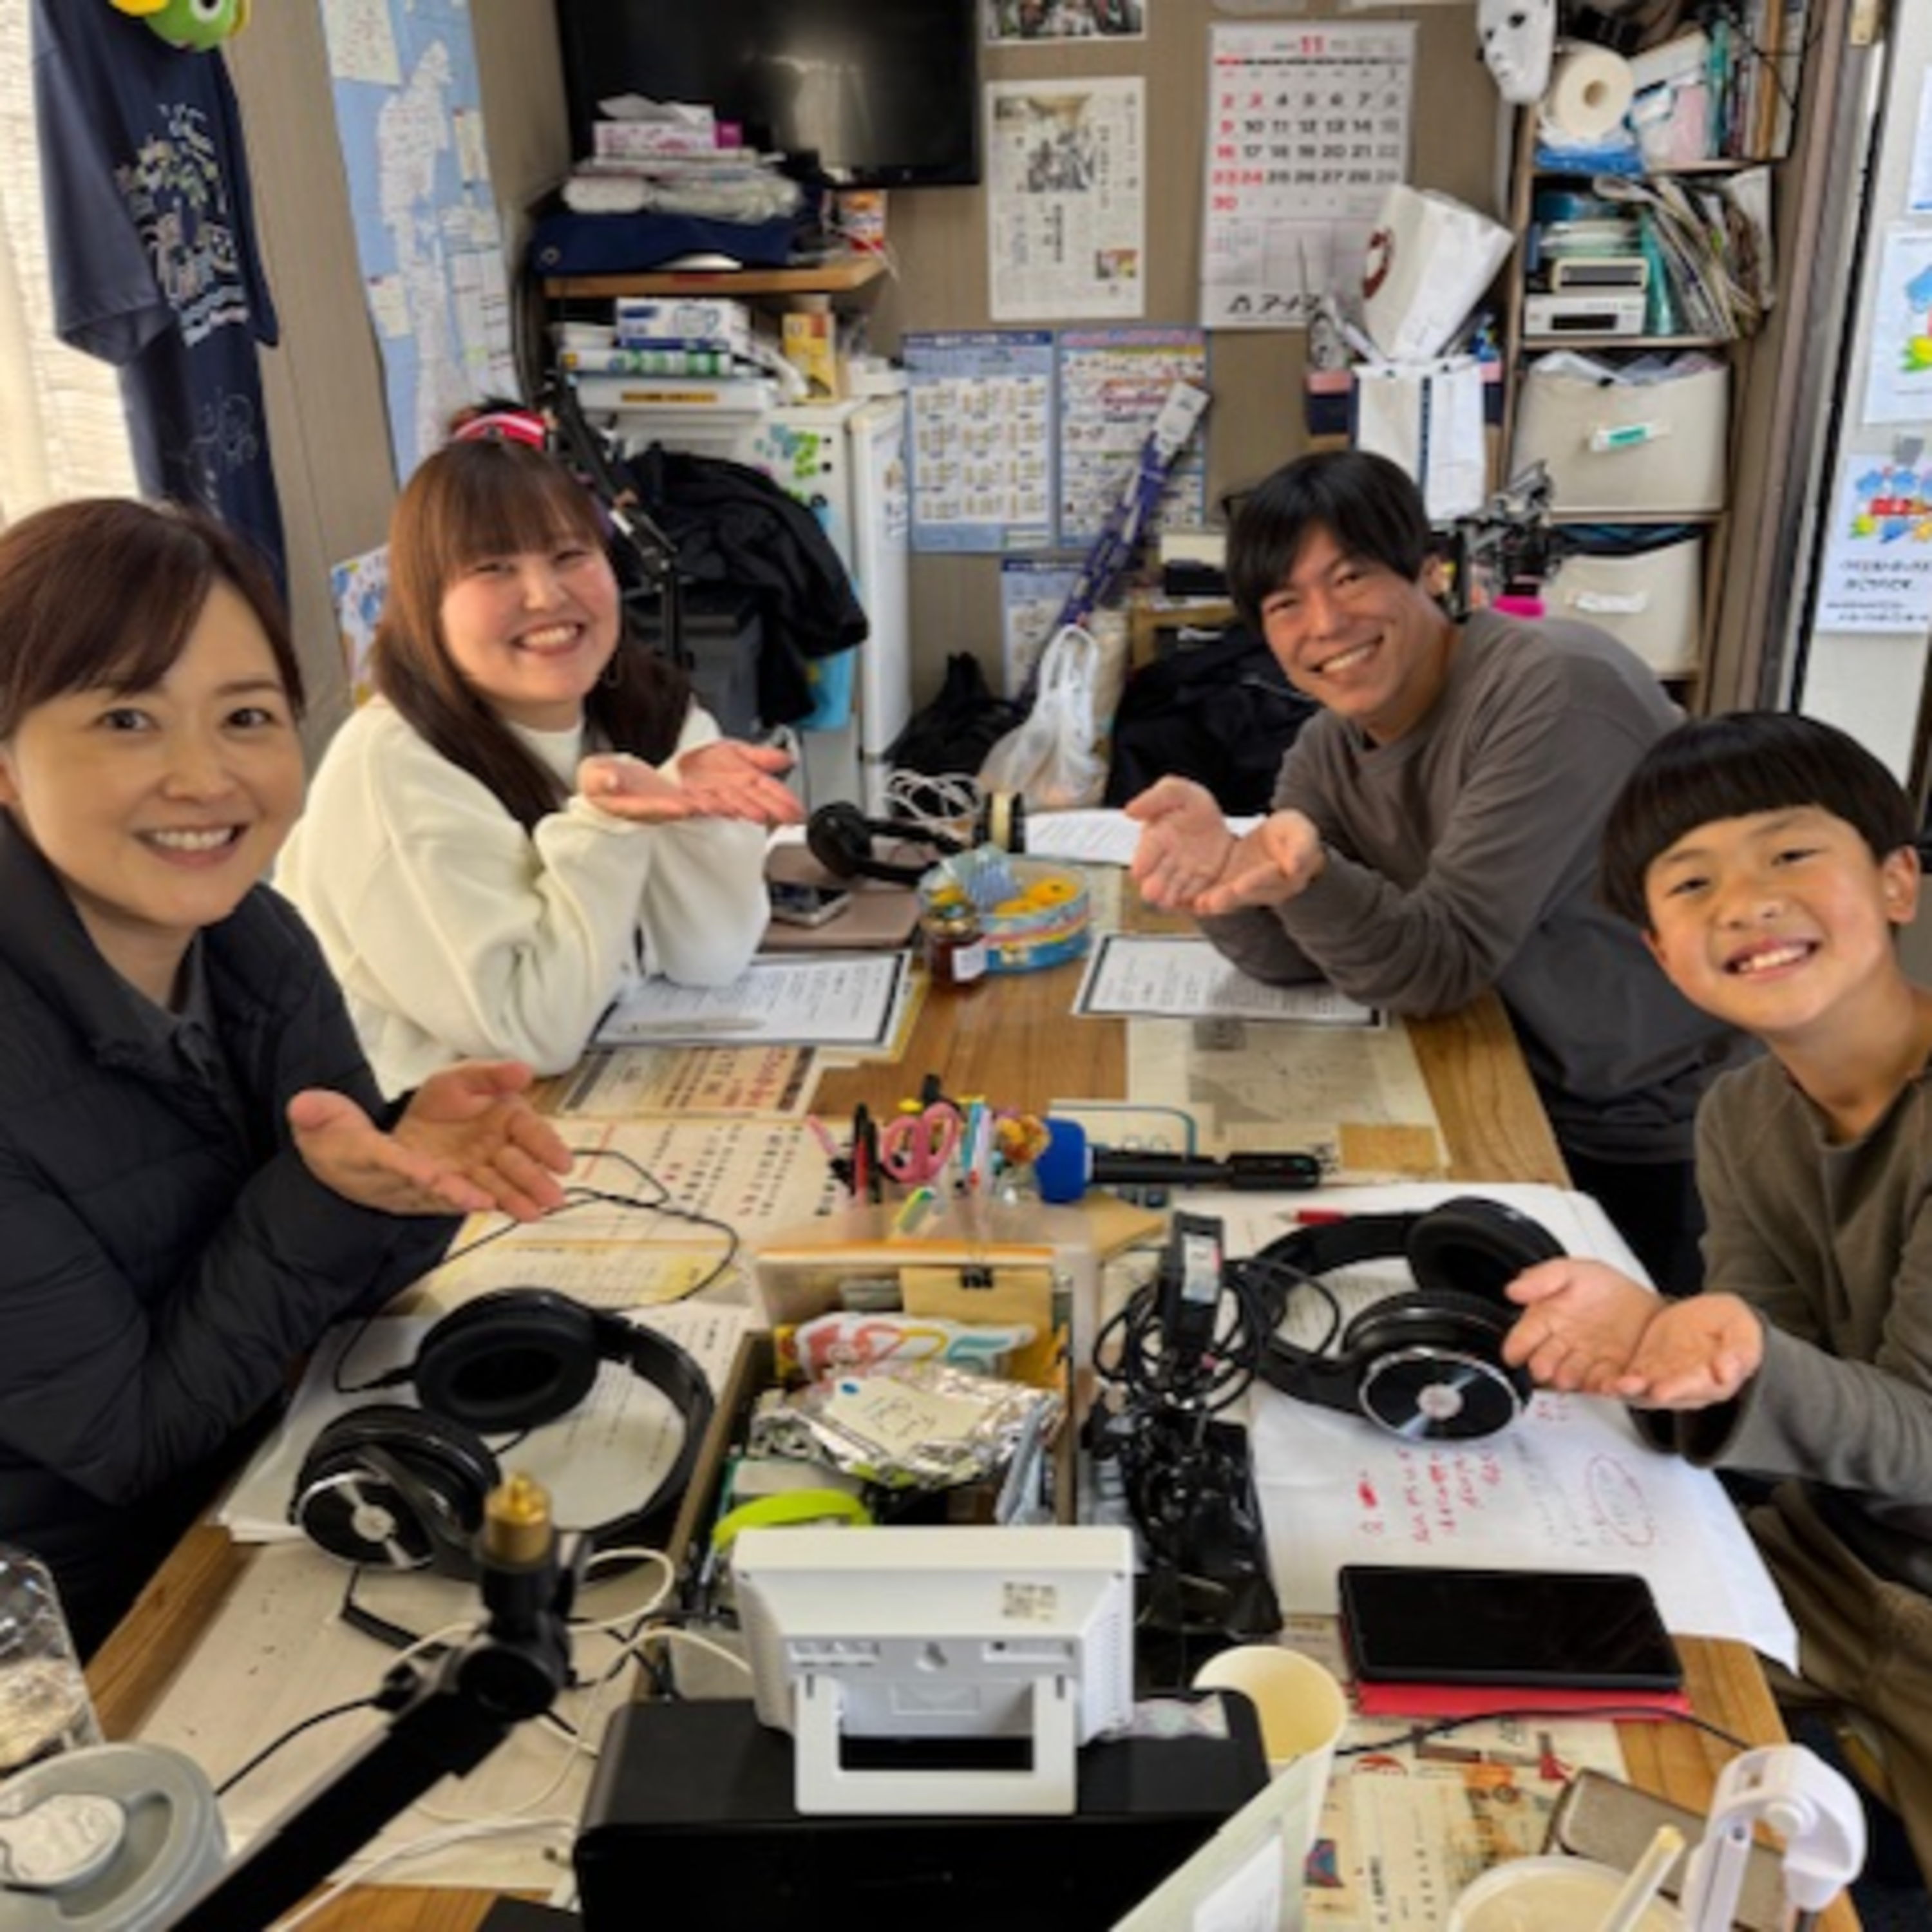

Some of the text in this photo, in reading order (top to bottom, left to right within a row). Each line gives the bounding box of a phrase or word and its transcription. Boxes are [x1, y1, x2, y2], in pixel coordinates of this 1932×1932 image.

[1222, 93, 1235, 109] 2
[1276, 93, 1288, 106] 4
[1330, 92, 1343, 106] 6
[1358, 92, 1372, 107] 7
[1244, 120, 1263, 133] 10
[1273, 120, 1289, 133] 11
[1354, 120, 1372, 133] 14
[1244, 144, 1264, 158] 17
[1322, 144, 1347, 158] 20
[1352, 144, 1372, 158] 21
[1322, 169, 1343, 183] 27
[1213, 195, 1238, 210] 30
